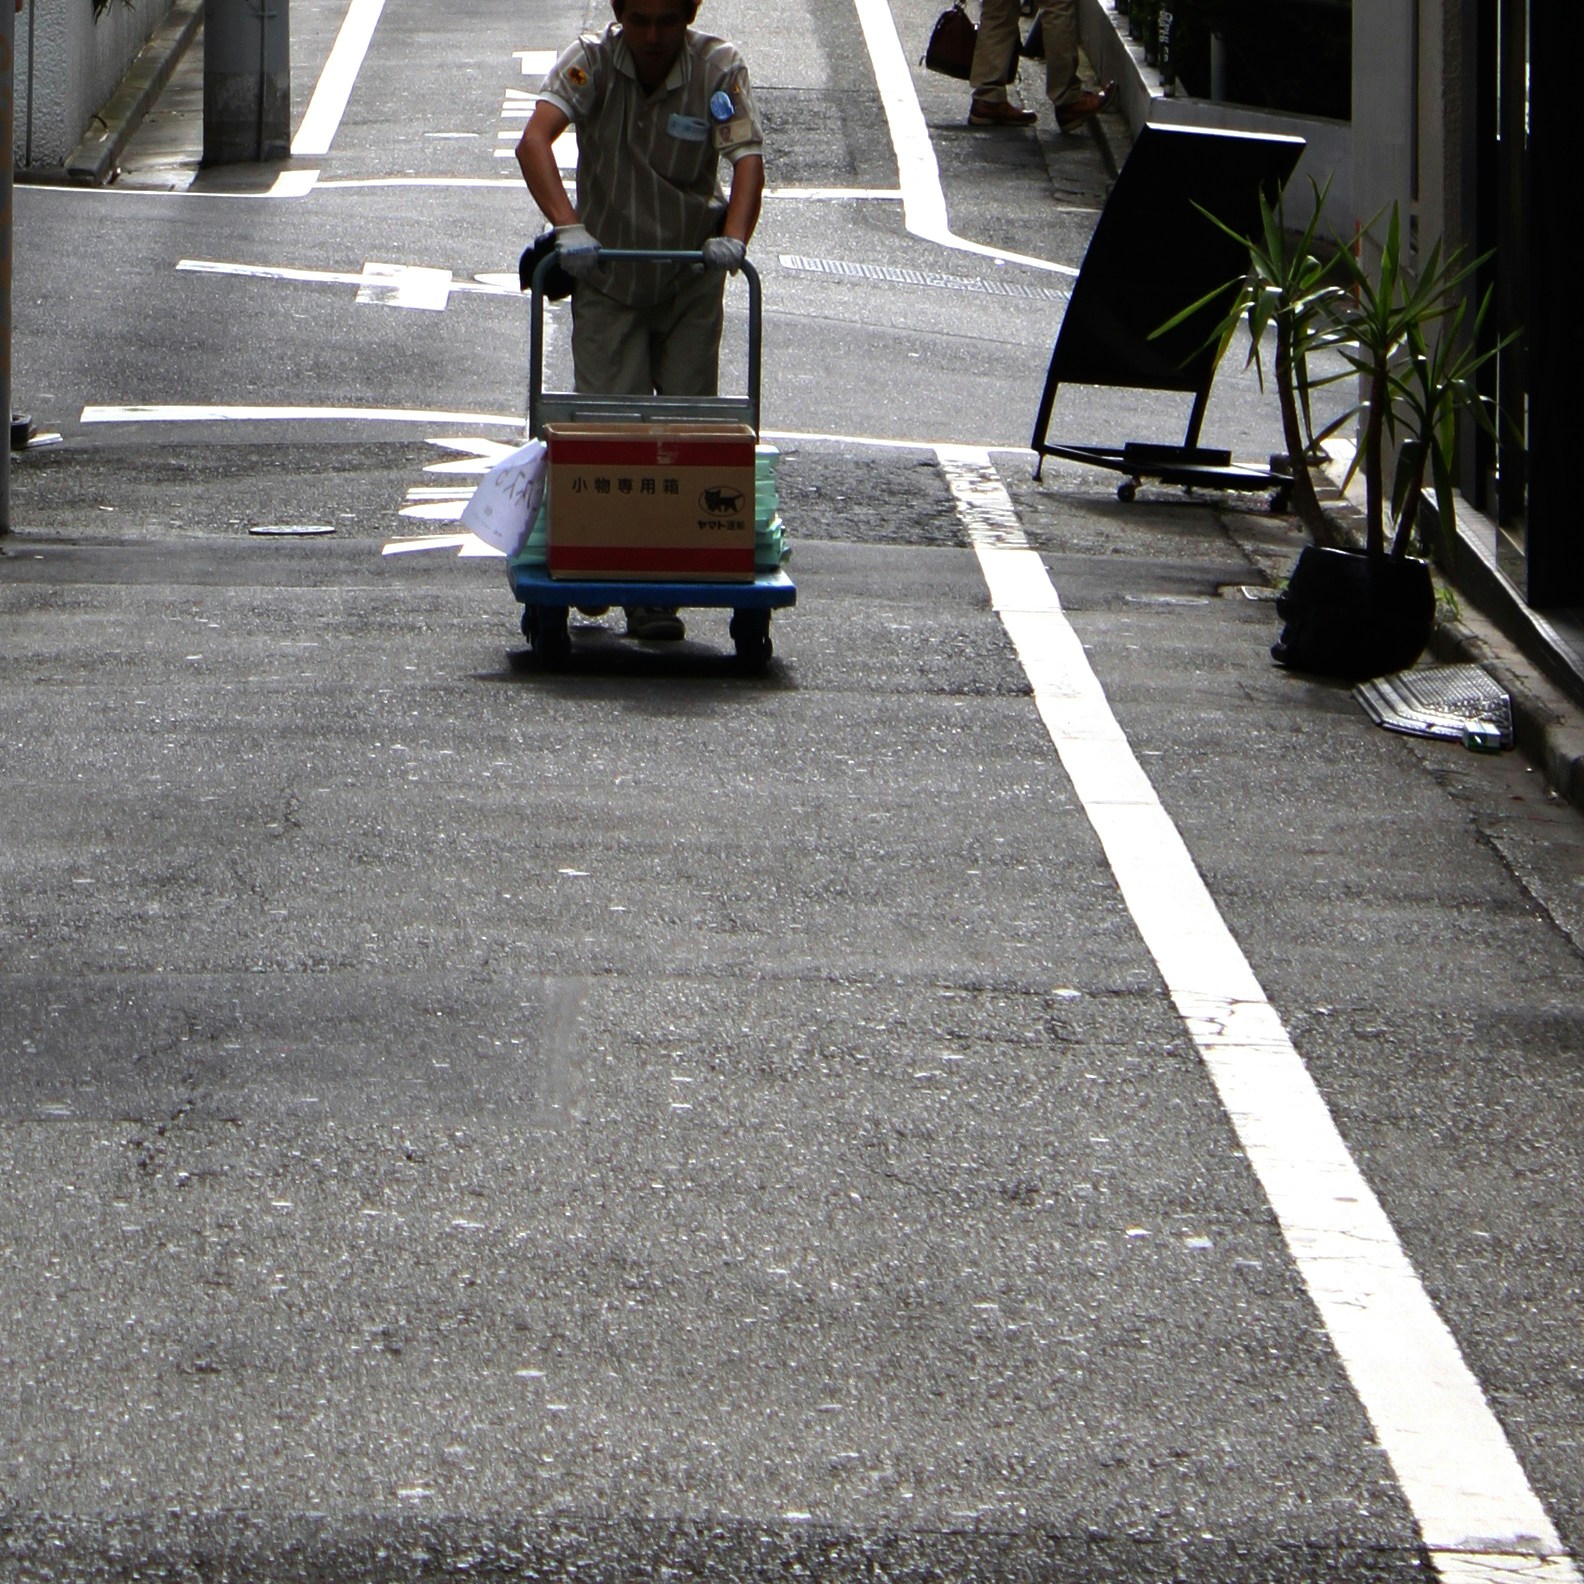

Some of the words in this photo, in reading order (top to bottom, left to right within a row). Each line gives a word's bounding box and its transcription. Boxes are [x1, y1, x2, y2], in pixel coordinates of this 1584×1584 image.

[571, 476, 681, 496] 小物専用箱
